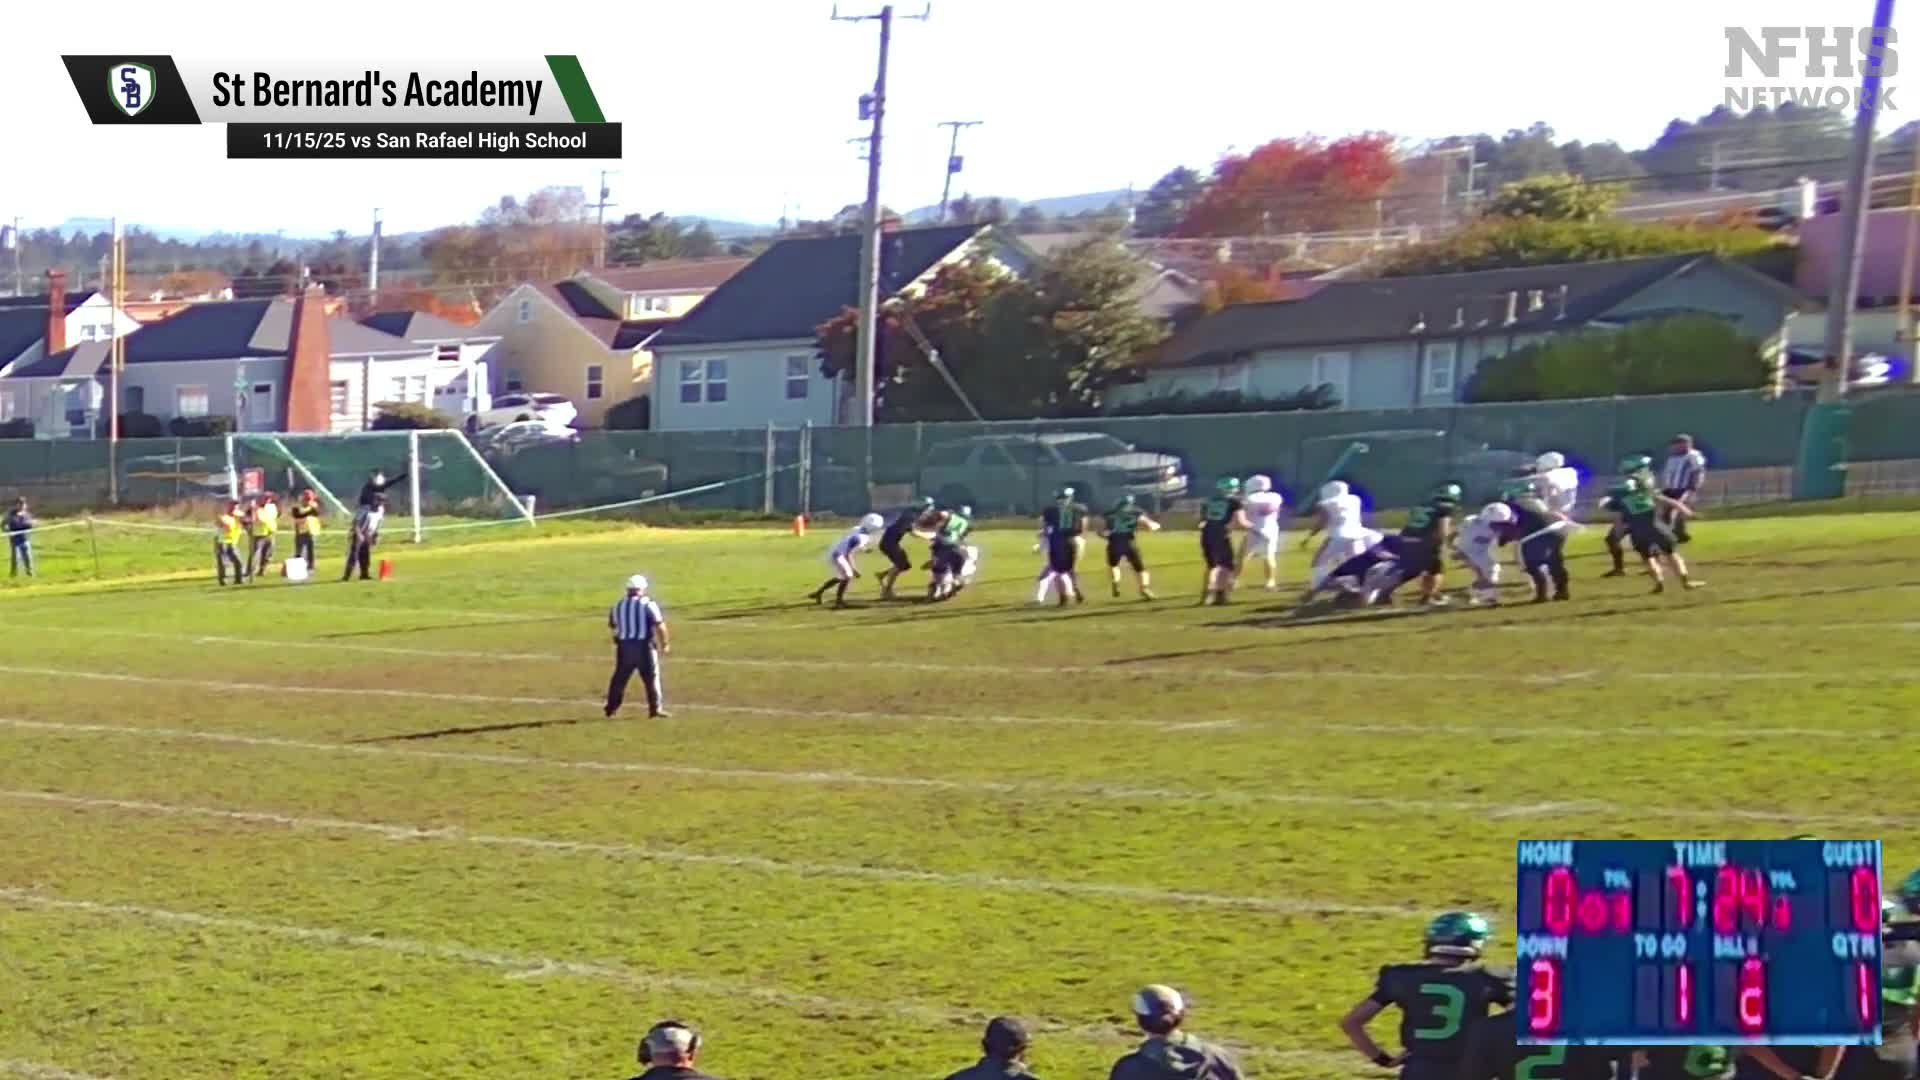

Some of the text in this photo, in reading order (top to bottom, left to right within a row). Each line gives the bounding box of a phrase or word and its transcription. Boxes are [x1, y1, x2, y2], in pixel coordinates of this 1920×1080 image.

[1520, 841, 1573, 866] HOME
[1673, 841, 1727, 866] TIME
[1822, 841, 1874, 867] GUEST
[1850, 866, 1877, 931] 0
[1516, 934, 1568, 959] DOWN
[1635, 936, 1687, 959] TO GO
[1415, 984, 1464, 1039] 3
[1530, 959, 1557, 1031] 3
[1676, 963, 1690, 1023] 1
[1857, 962, 1872, 1023] 1
